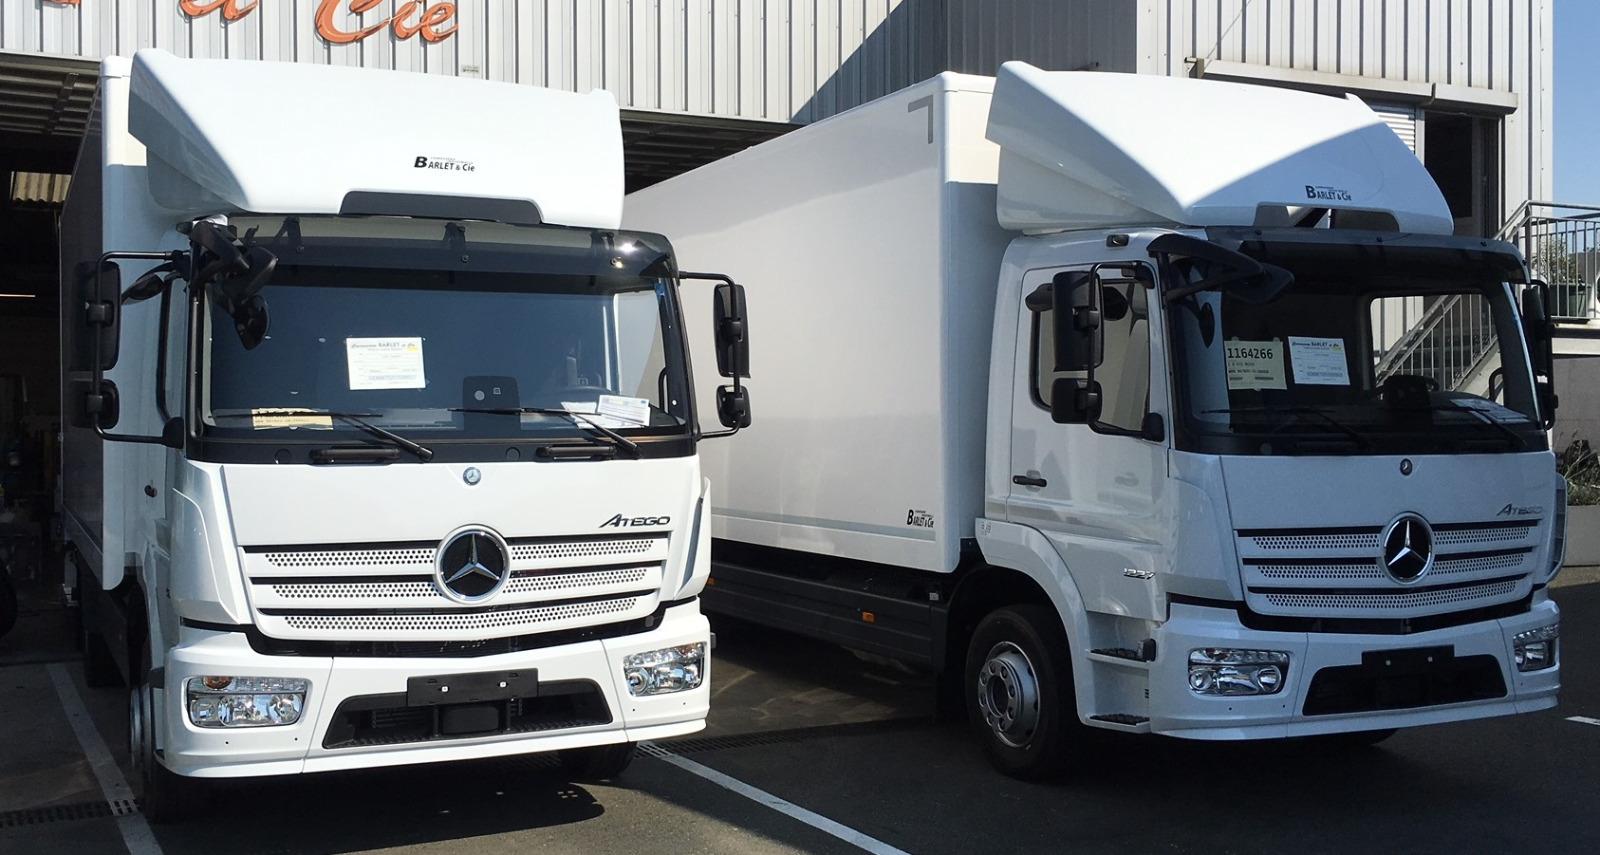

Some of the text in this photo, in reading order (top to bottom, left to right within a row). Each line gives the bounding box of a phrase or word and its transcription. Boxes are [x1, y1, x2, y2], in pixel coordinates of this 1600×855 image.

[414, 156, 455, 170] BARLET
[462, 163, 476, 172] Cie
[1305, 185, 1336, 200] BARLET
[1227, 347, 1274, 360] 1164266
[598, 513, 671, 528] ATEGO
[1123, 567, 1155, 580] 1227
